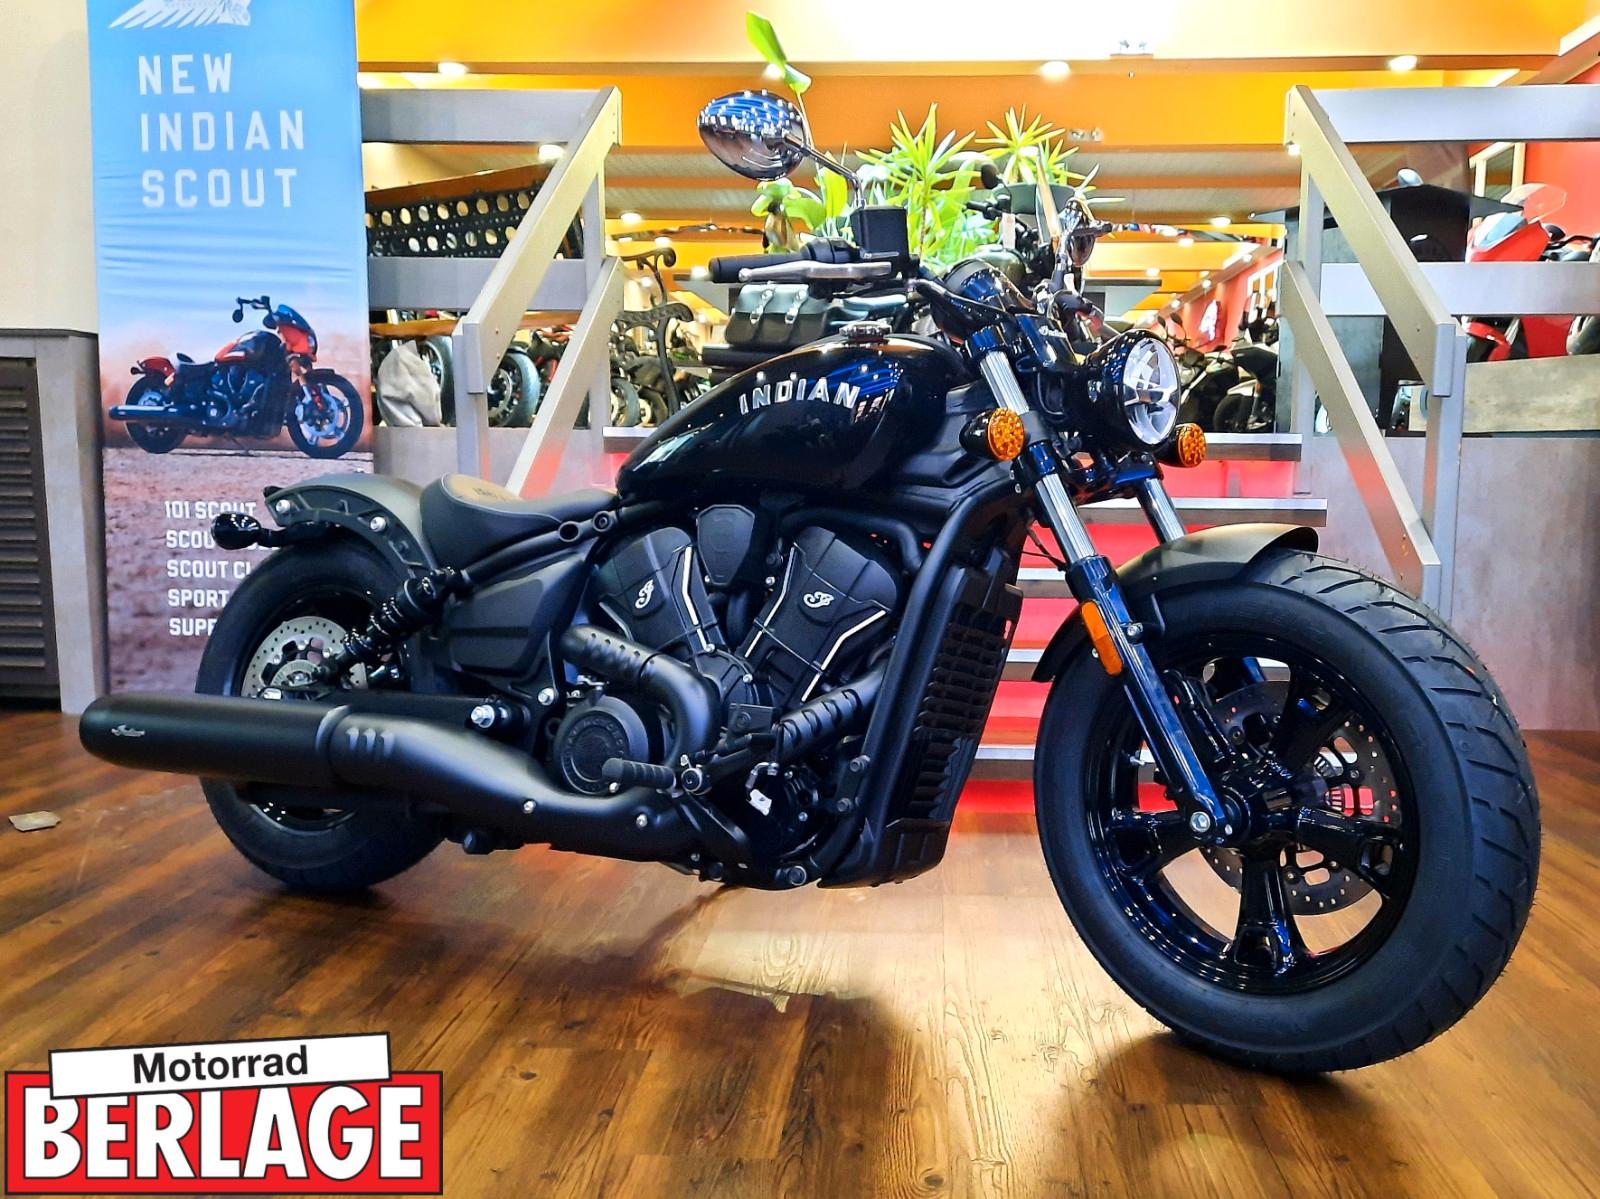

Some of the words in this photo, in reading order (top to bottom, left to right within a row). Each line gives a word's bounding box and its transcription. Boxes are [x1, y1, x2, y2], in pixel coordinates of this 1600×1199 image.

[138, 53, 232, 95] NEW
[140, 110, 304, 152] INDIAN
[142, 168, 297, 208] SCOUT
[739, 377, 860, 415] INDIAN
[165, 501, 190, 519] 101
[166, 530, 216, 549] SCOU
[167, 560, 229, 579] SCOUT
[168, 589, 229, 608] SPORT
